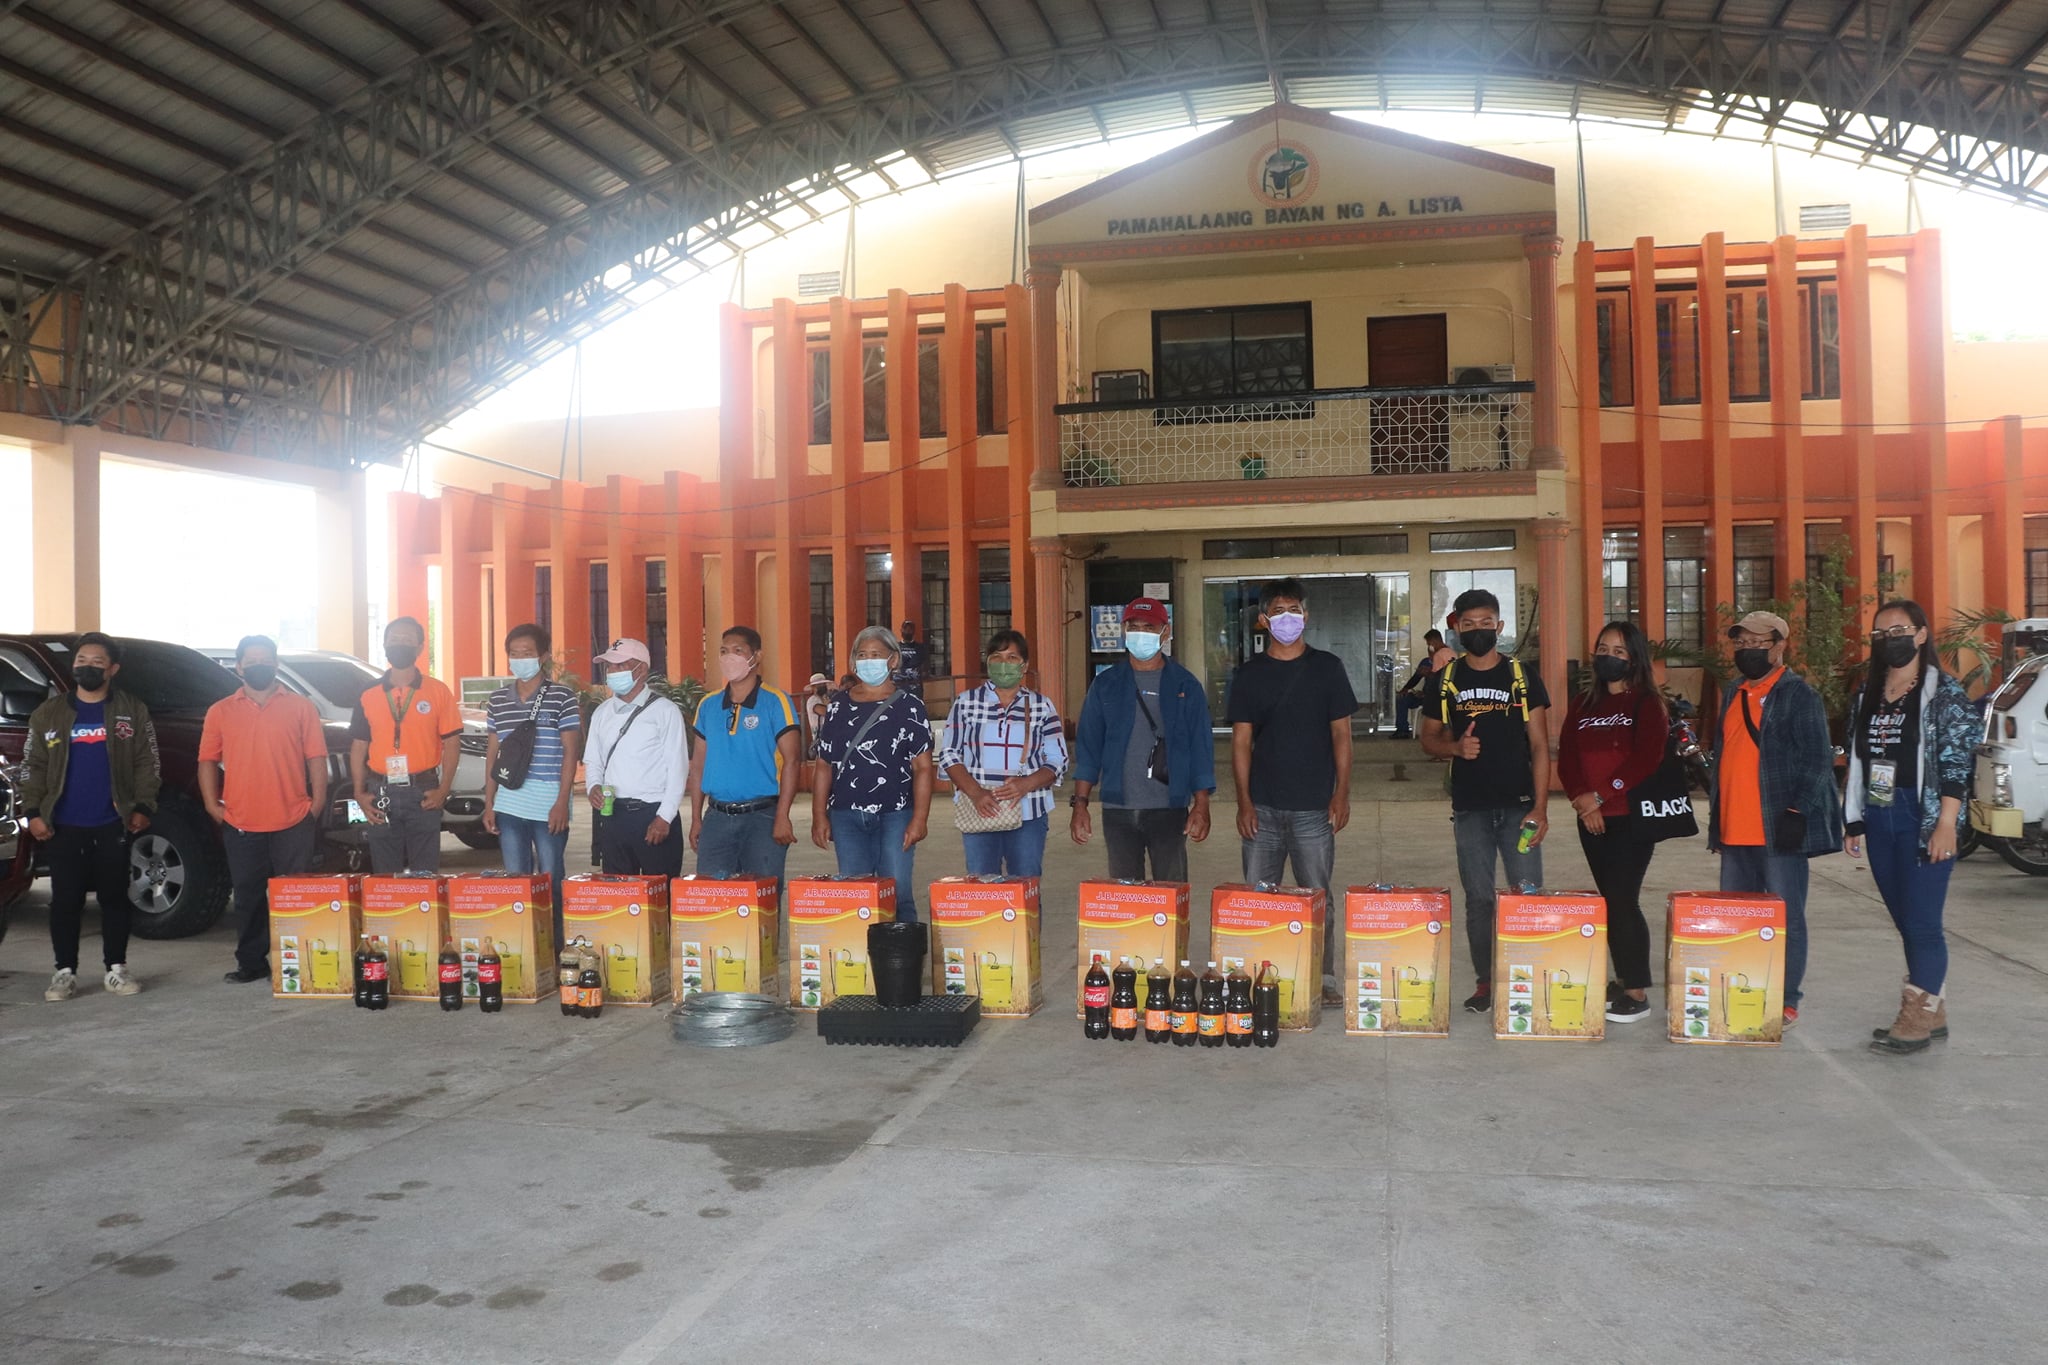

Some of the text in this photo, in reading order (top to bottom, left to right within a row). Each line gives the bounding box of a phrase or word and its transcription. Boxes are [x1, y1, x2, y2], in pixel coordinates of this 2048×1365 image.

[1107, 196, 1463, 235] PAMAHALAANG BAYAN NG A. LISTA
[1476, 688, 1510, 702] DUTCH
[1641, 797, 1692, 817] BLACK
[1096, 892, 1166, 904] J.B.KAWASAKI
[1230, 898, 1302, 912] J.B.KAWASAKI
[1517, 904, 1594, 914] J.B.KAWASAKI
[1693, 906, 1774, 917] J.B.KAWASAKI
